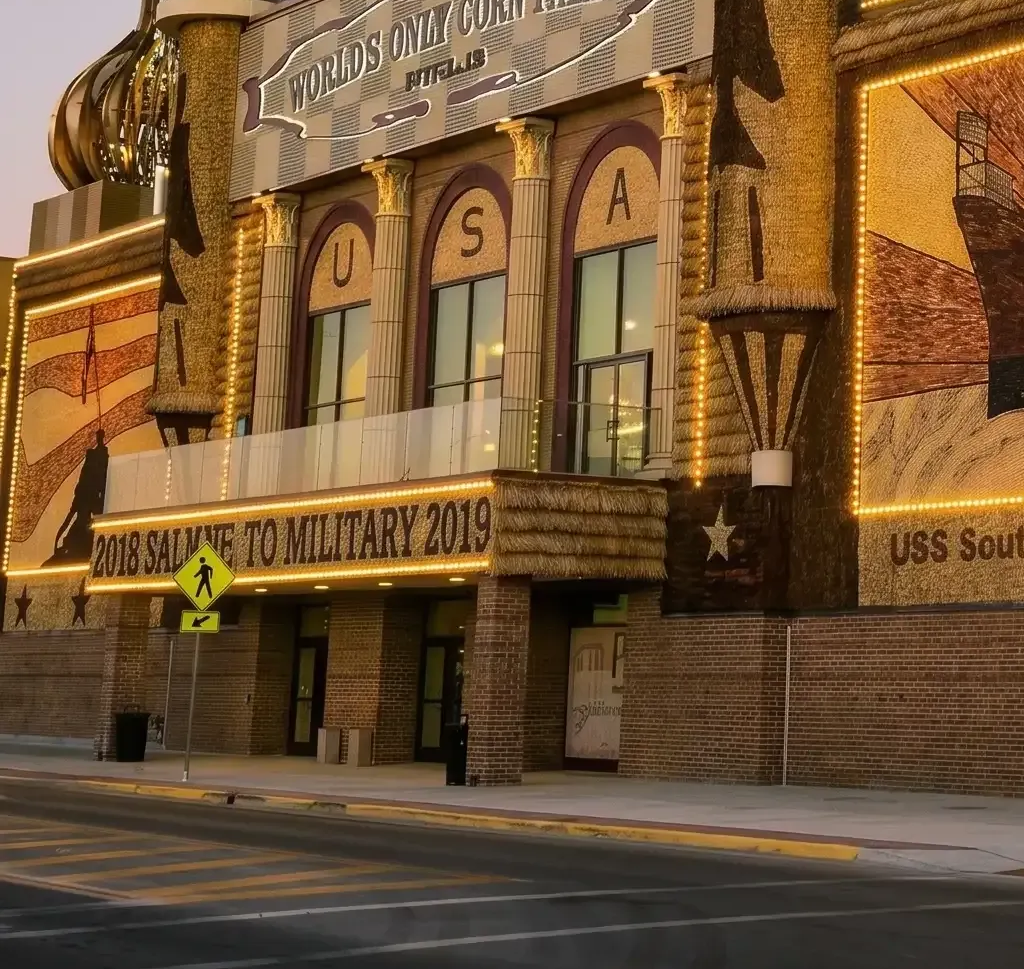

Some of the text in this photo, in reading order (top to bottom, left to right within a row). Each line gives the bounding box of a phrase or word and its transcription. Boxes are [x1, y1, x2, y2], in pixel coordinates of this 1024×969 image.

[289, 30, 381, 113] WORLDS
[389, 2, 453, 61] ONLY
[333, 167, 631, 287] U S A
[92, 530, 140, 578] 2018
[243, 516, 278, 568] TO
[284, 504, 418, 565] MILITARY
[425, 496, 492, 555] 2019
[891, 529, 948, 566] USS
